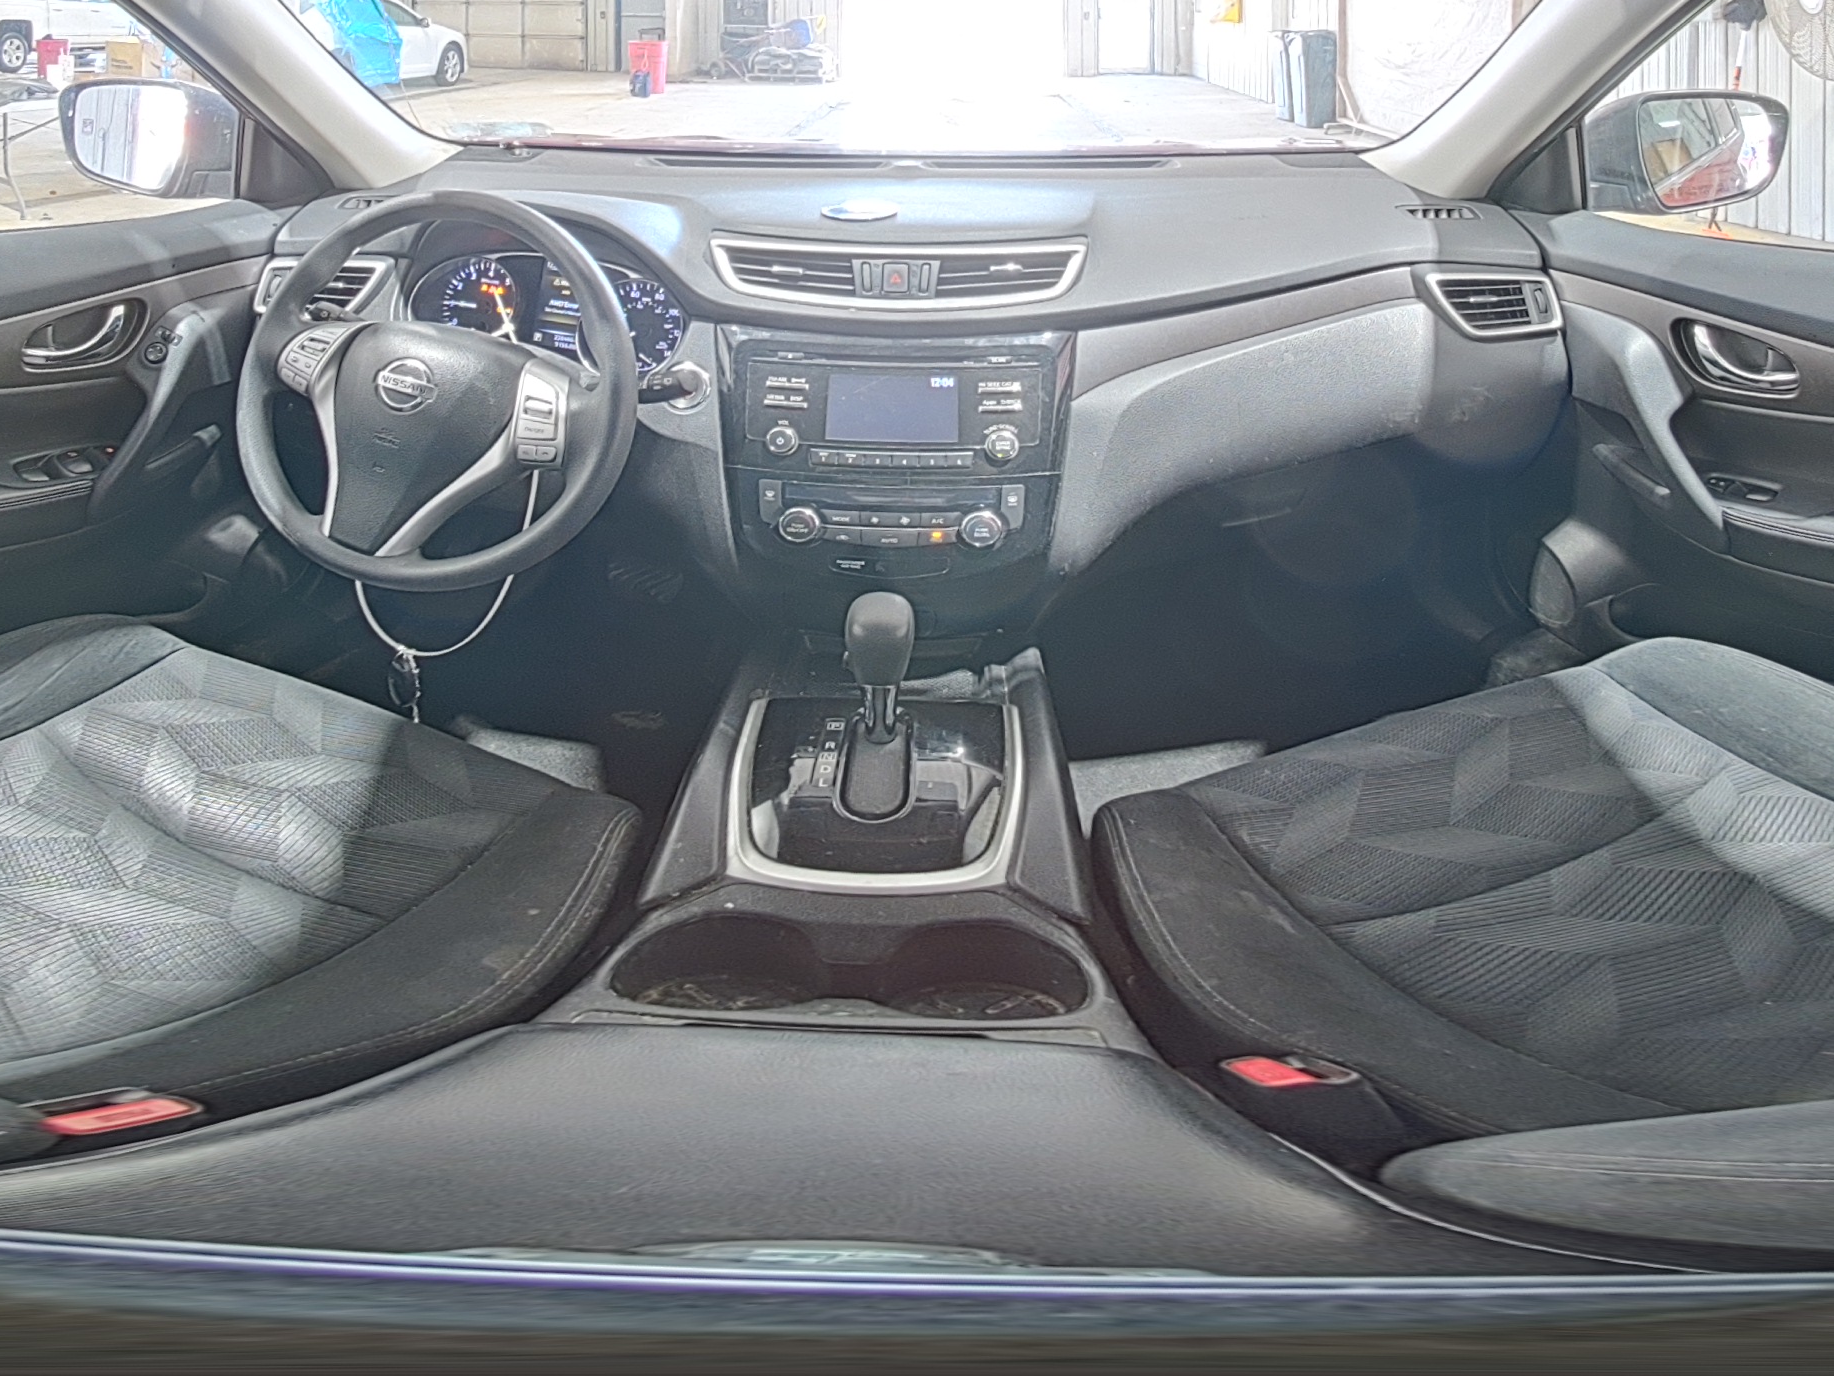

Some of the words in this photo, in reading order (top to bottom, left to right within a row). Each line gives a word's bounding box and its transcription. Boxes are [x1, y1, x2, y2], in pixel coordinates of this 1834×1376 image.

[381, 374, 427, 395] NISSAN
[931, 377, 954, 388] 12:04
[825, 741, 836, 749] R
[820, 765, 832, 773] D
[818, 779, 829, 787] L
